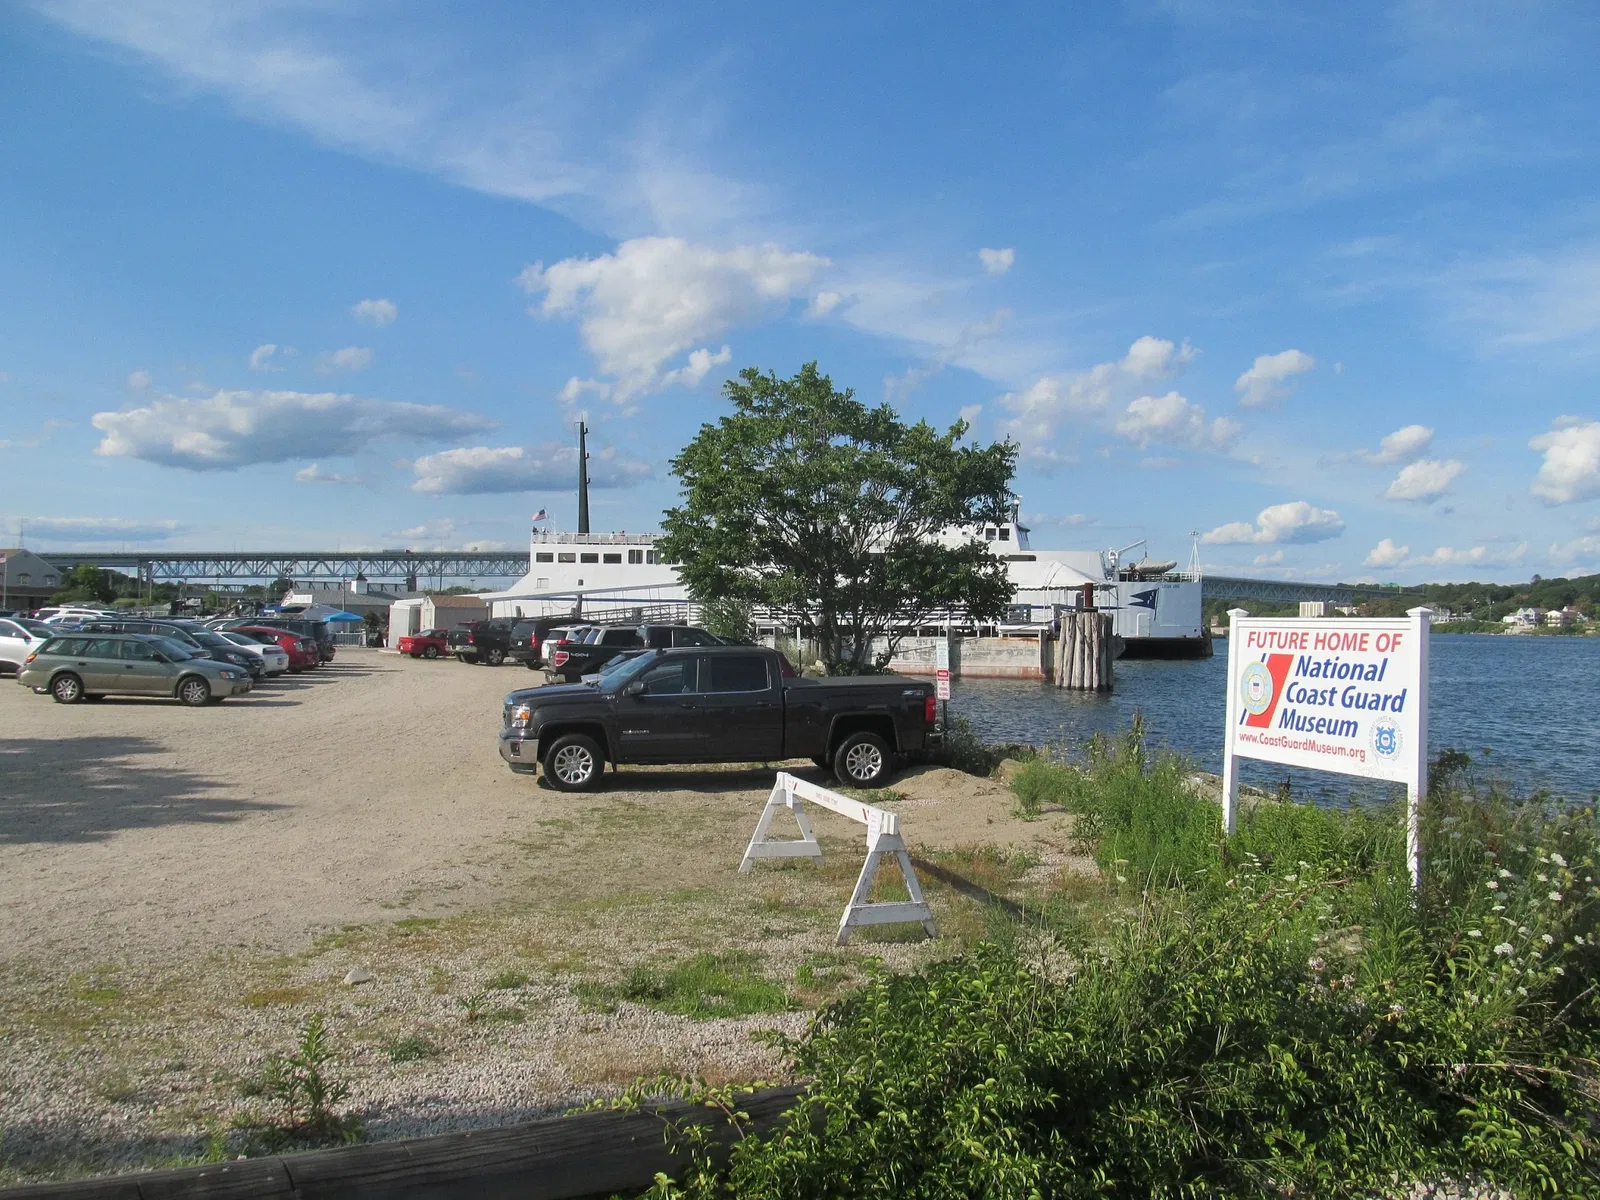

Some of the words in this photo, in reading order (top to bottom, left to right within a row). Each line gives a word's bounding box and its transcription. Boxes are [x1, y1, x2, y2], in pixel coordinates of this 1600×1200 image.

[1247, 631, 1309, 649] FUTURE
[1314, 632, 1369, 651] HOME
[1375, 633, 1403, 652] OF
[1295, 655, 1388, 682] National
[1286, 681, 1337, 707] Coast
[1341, 685, 1407, 712] Guard
[1278, 708, 1358, 738] Museum
[1239, 732, 1366, 762] www.CoastGuardMuseum.org
